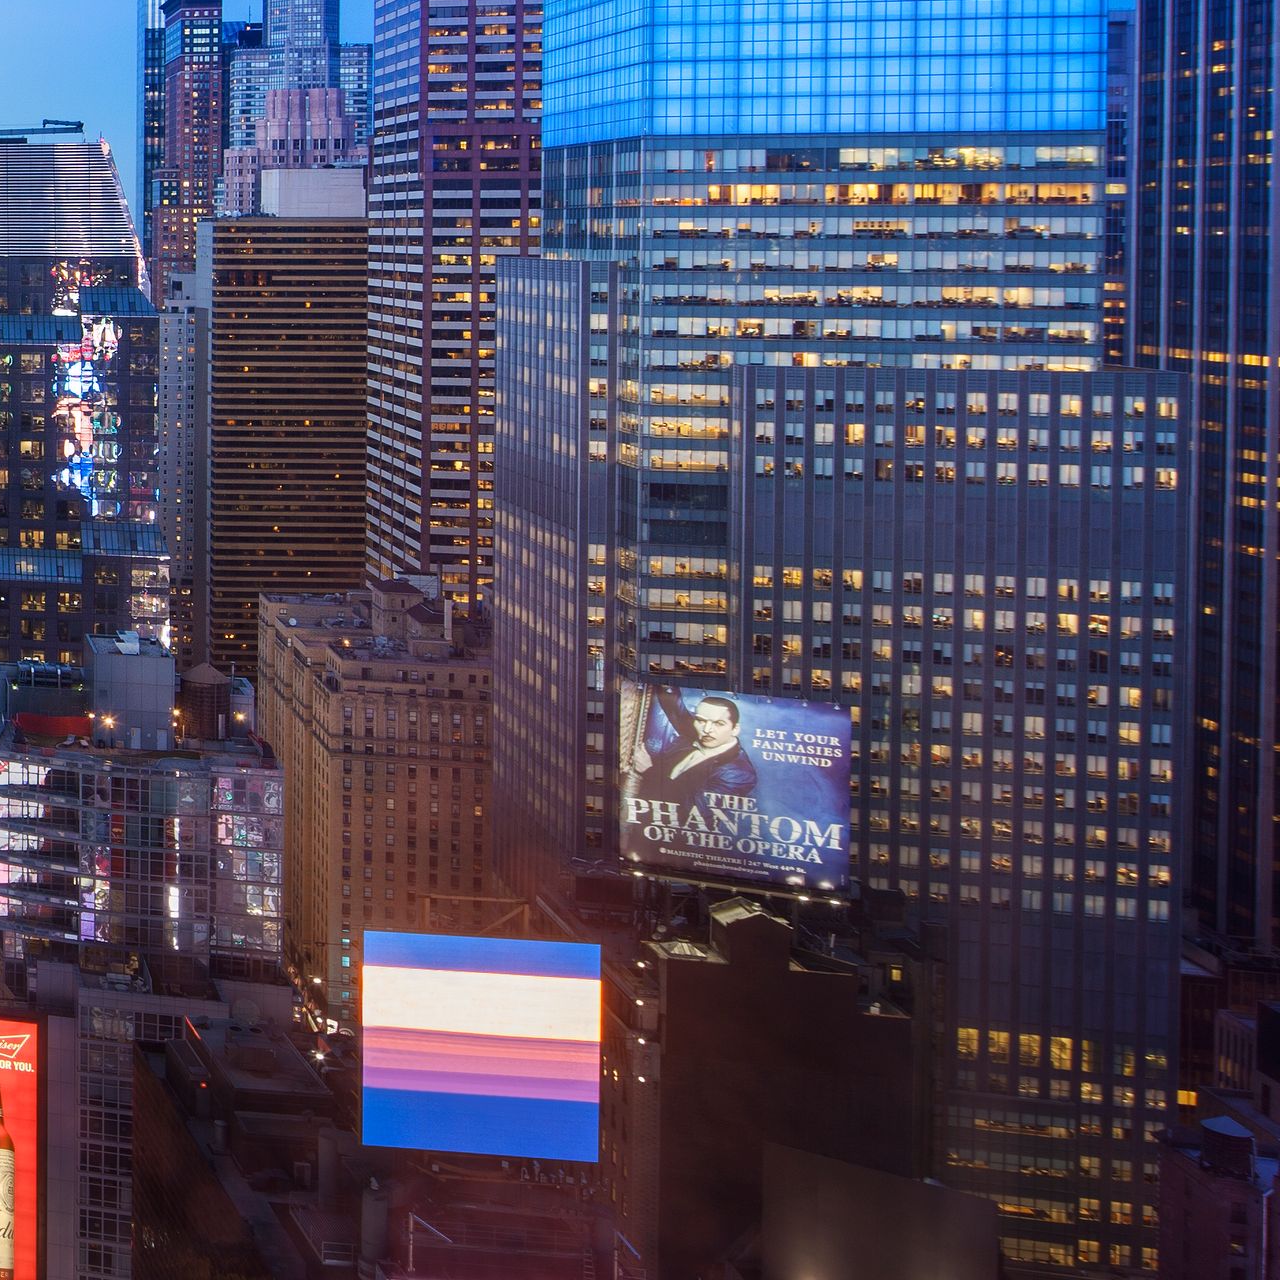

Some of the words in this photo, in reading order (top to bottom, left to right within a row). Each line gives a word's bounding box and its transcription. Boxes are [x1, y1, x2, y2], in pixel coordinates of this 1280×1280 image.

[755, 728, 787, 740] LET
[793, 732, 841, 746] YOUR
[752, 739, 843, 758] FANTASIES
[762, 751, 832, 768] UNWIND
[704, 791, 758, 813] THE
[624, 797, 844, 851] PHANTOM
[643, 825, 678, 843] OF
[681, 831, 734, 851] THE
[736, 838, 824, 865] OPERA
[666, 849, 704, 860] MAJESTIC
[705, 853, 743, 865] THEATRE
[762, 862, 779, 871] West
[13, 1061, 35, 1073] YOU.
